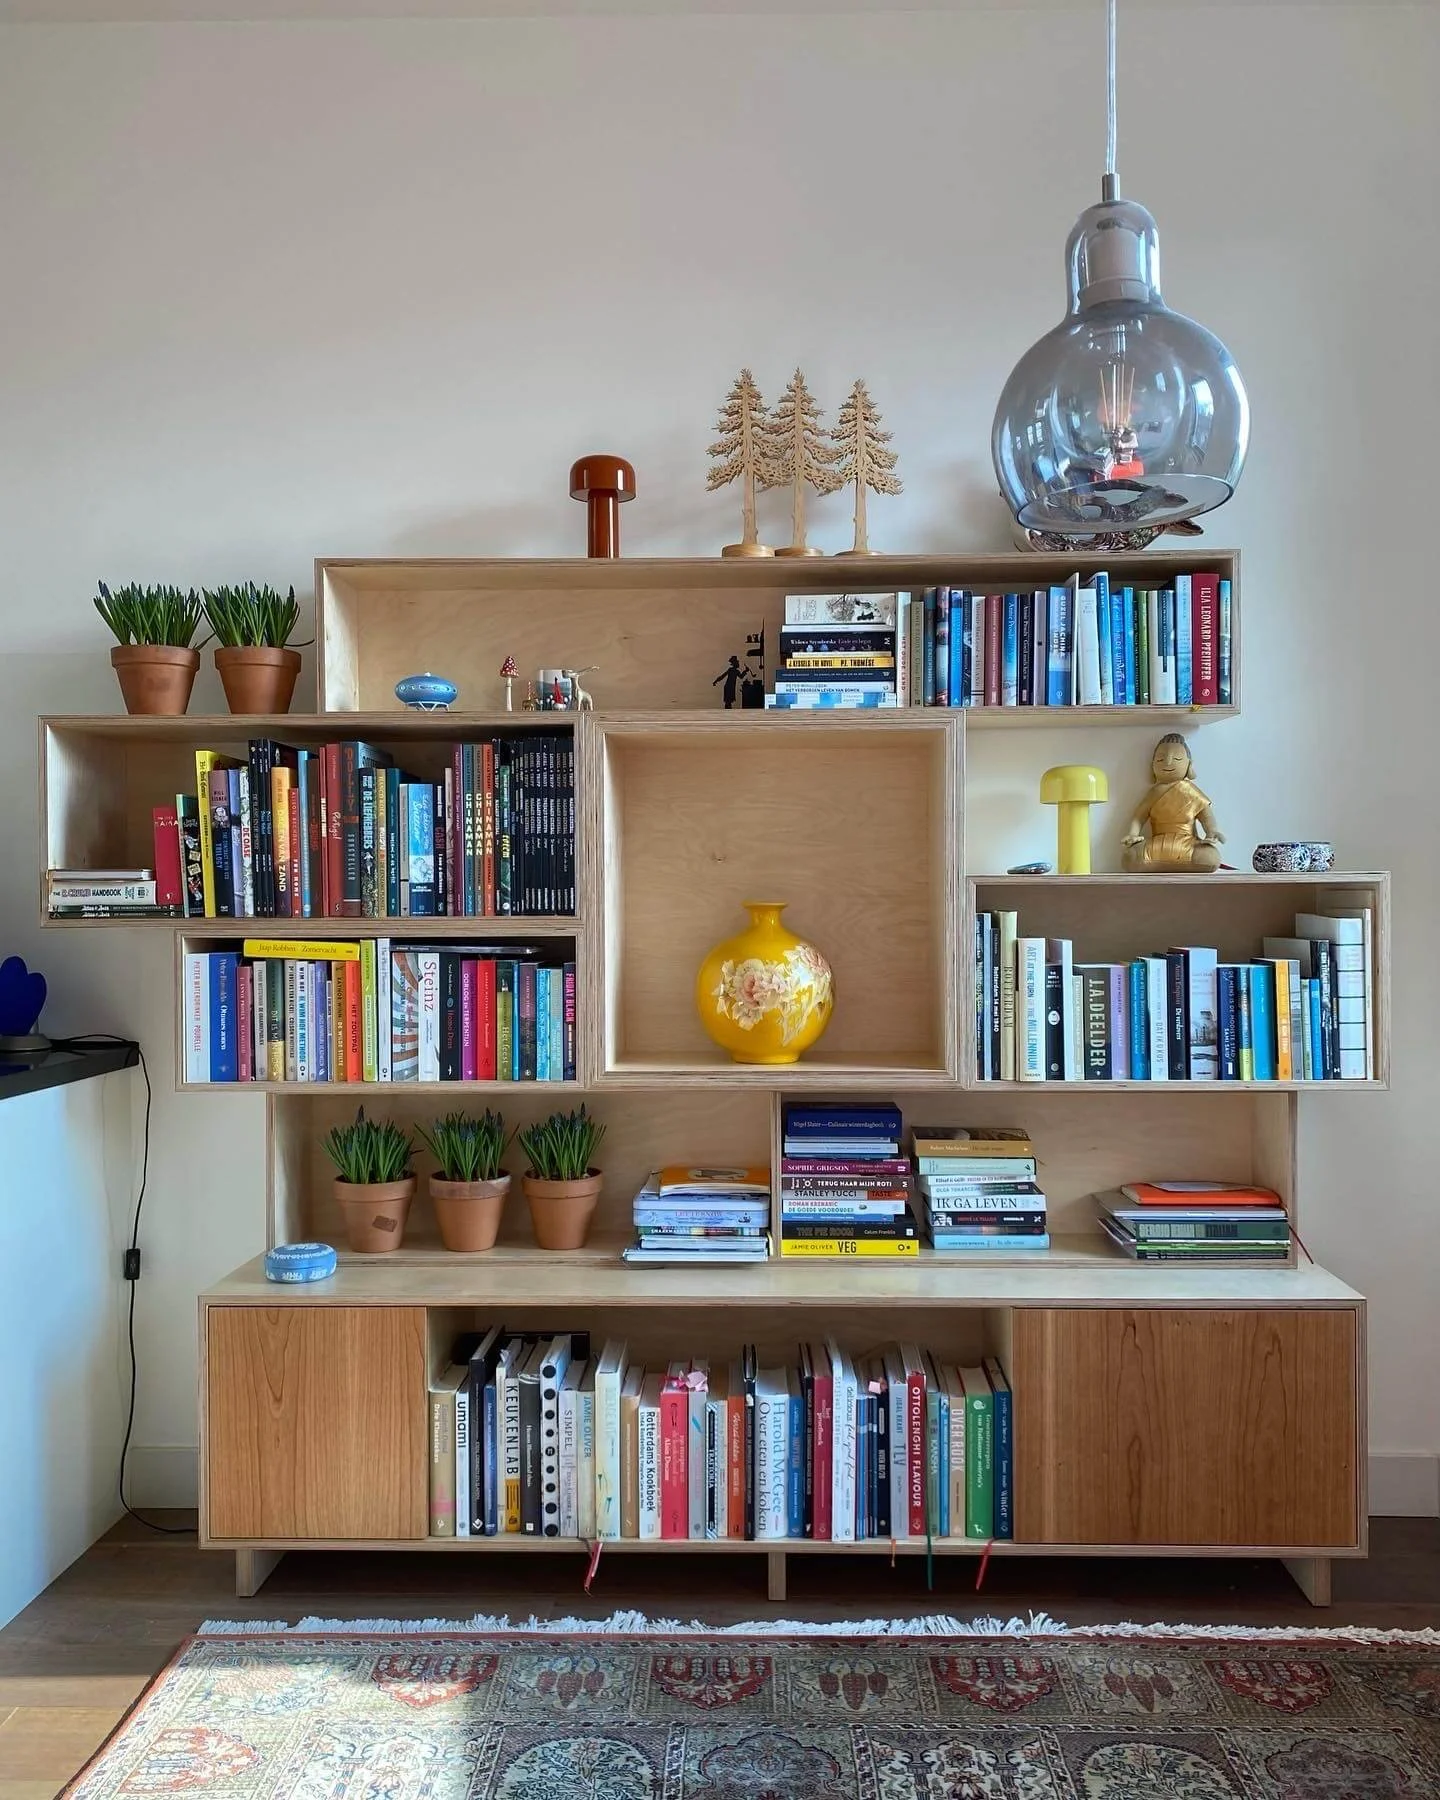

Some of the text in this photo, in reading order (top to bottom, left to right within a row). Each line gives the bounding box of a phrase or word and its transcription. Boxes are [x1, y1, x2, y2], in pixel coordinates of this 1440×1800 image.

[1200, 587, 1212, 603] ILJA
[1200, 606, 1212, 640] LEONARD
[243, 827, 250, 837] DE
[363, 791, 373, 849] DE LIEFHEBBERS
[465, 793, 473, 856] CHINAMAN
[486, 792, 494, 855] CHINAMAN
[435, 827, 444, 849] CASH
[215, 843, 223, 868] TRILOGY
[92, 889, 122, 897] HANDBOOK
[278, 865, 286, 892] ZAND
[1026, 946, 1037, 962] ART
[1027, 962, 1034, 970] AT
[424, 961, 438, 1012] Steinz
[565, 973, 574, 1022] FRIDAY BLACK
[1003, 966, 1013, 1028] ROTTERDAM
[271, 1010, 279, 1022] DIT
[337, 1021, 343, 1029] DE
[1228, 1004, 1235, 1013] DE
[1027, 1019, 1037, 1070] MILLENNIUM
[936, 1198, 1017, 1209] IK GA LEVEN
[838, 1241, 856, 1253] VEG
[457, 1401, 466, 1448] umami
[506, 1385, 519, 1474] KEUKENLAB
[564, 1410, 573, 1450] SIMPEL
[583, 1396, 592, 1458] JAMIE OLIVER
[951, 1409, 964, 1472] OVER ROOK
[646, 1411, 656, 1512] Rotterdams Kookboek
[772, 1402, 786, 1512] Harold McGee
[893, 1443, 906, 1466] TLV
[912, 1387, 921, 1507] OTTOLENGHI FLAVOUR
[930, 1440, 938, 1474] KANSHA
[758, 1402, 770, 1531] Over eten en koken
[1000, 1490, 1008, 1518] winter
